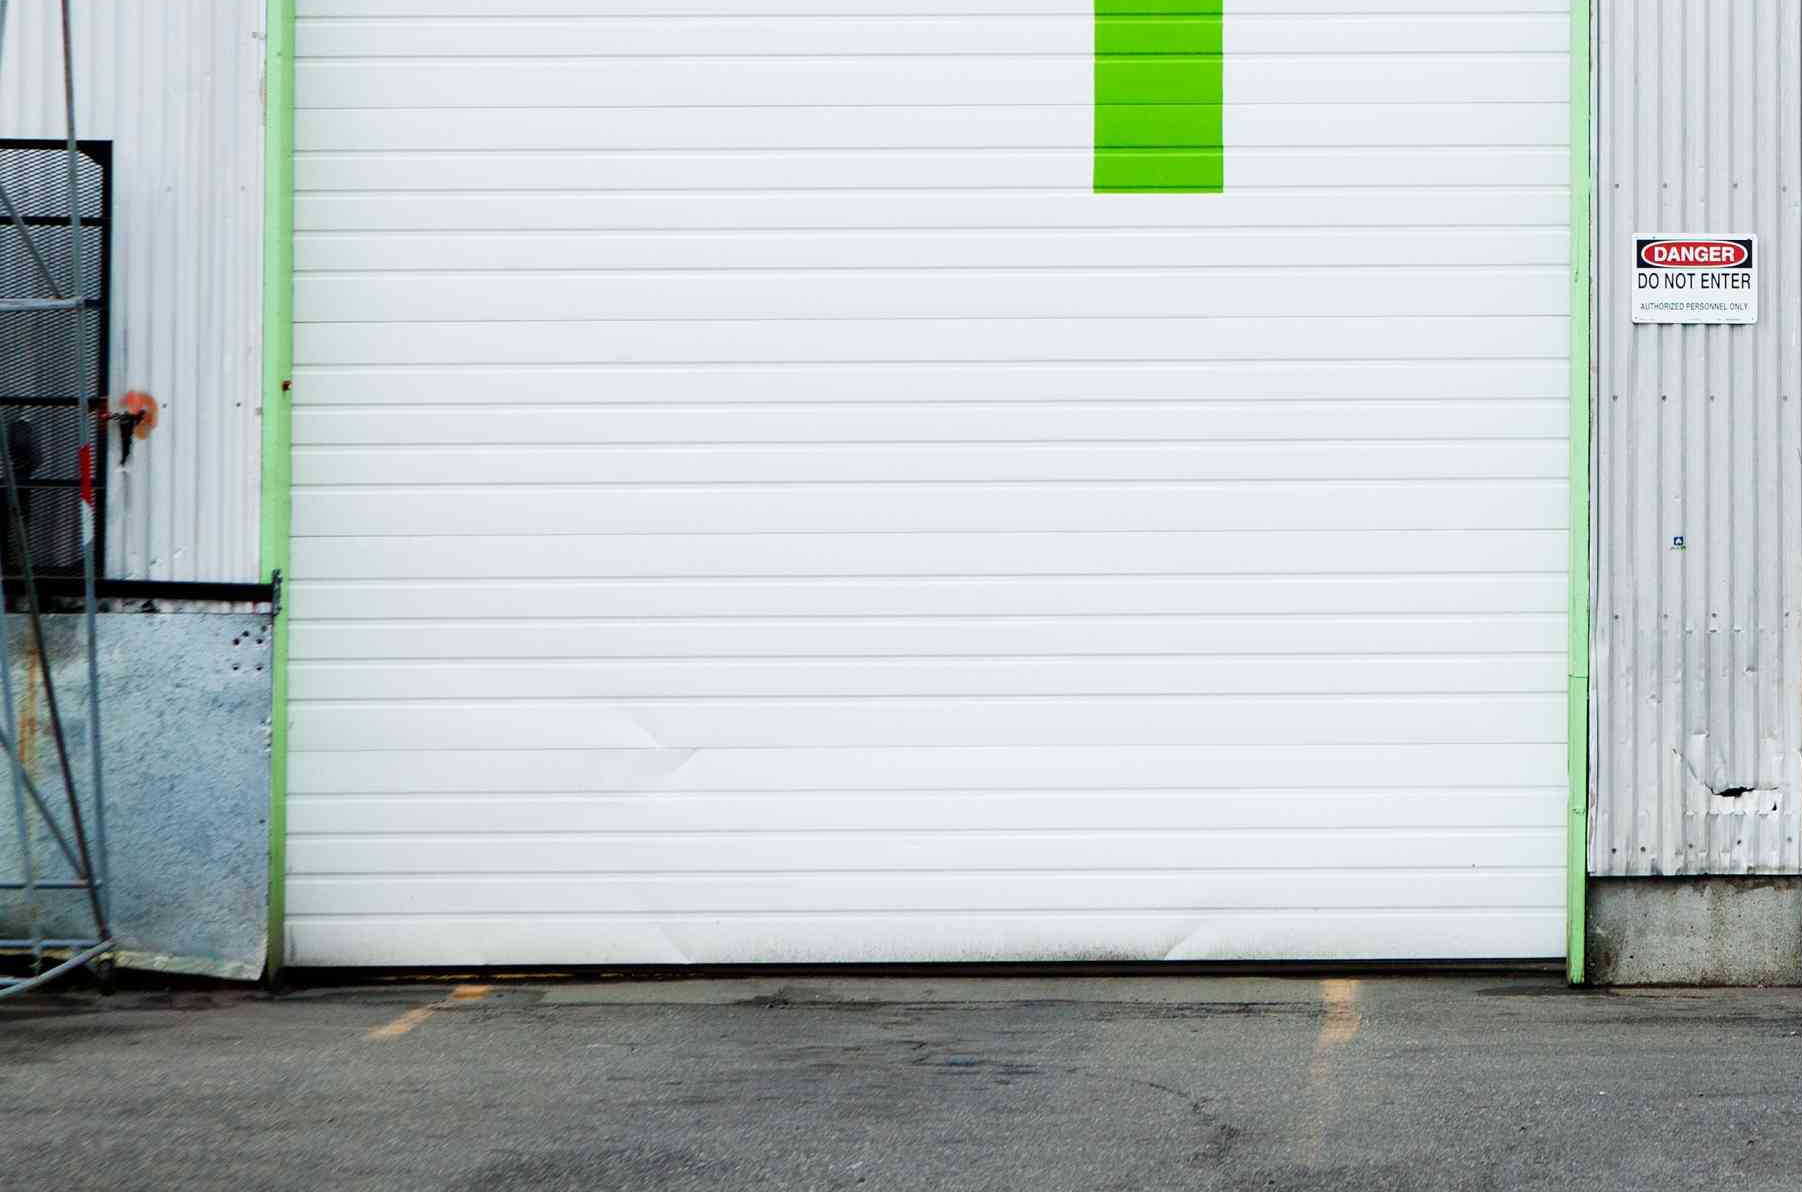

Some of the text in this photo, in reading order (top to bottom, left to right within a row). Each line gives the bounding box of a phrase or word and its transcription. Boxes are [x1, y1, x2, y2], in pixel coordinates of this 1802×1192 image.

[1653, 246, 1735, 262] DANGER
[1638, 272, 1751, 289] DO NOT ENTER
[1640, 302, 1749, 311] AUTHORIZED PERSONNEL ONLY
